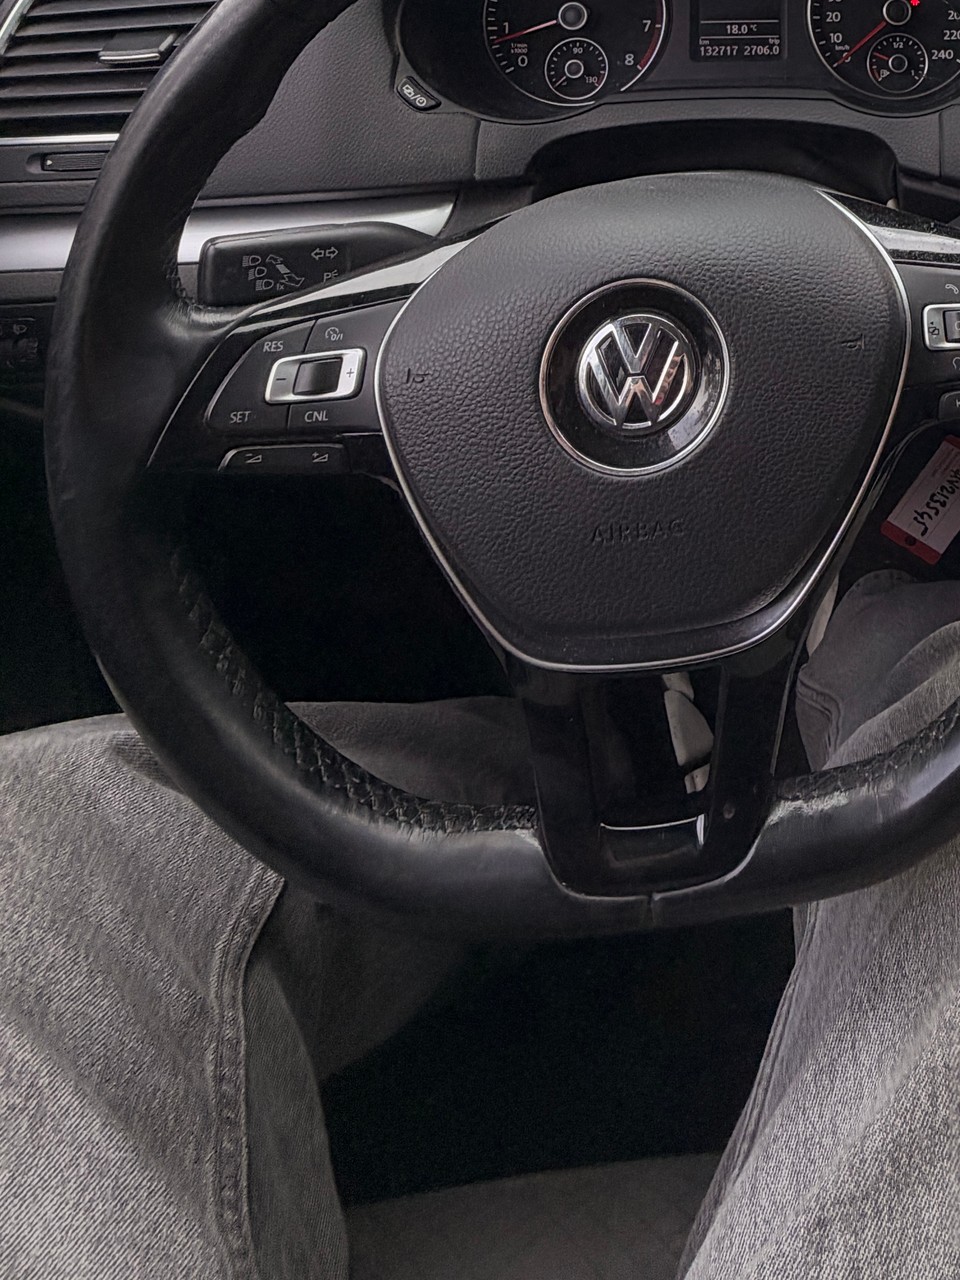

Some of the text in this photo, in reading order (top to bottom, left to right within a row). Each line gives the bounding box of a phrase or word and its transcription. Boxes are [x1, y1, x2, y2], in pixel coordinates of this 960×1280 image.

[826, 11, 841, 22] 20
[503, 22, 509, 34] 1
[642, 20, 651, 32] 7
[726, 24, 748, 34] 18.0
[829, 33, 842, 43] 10
[700, 45, 780, 56] 132717 2706.0
[931, 49, 954, 60] 240
[518, 55, 528, 67] 0
[625, 53, 634, 65] 8
[263, 341, 284, 353] RES
[230, 411, 251, 424] SET
[304, 410, 329, 422] CNL
[592, 519, 685, 545] AIRBAG
